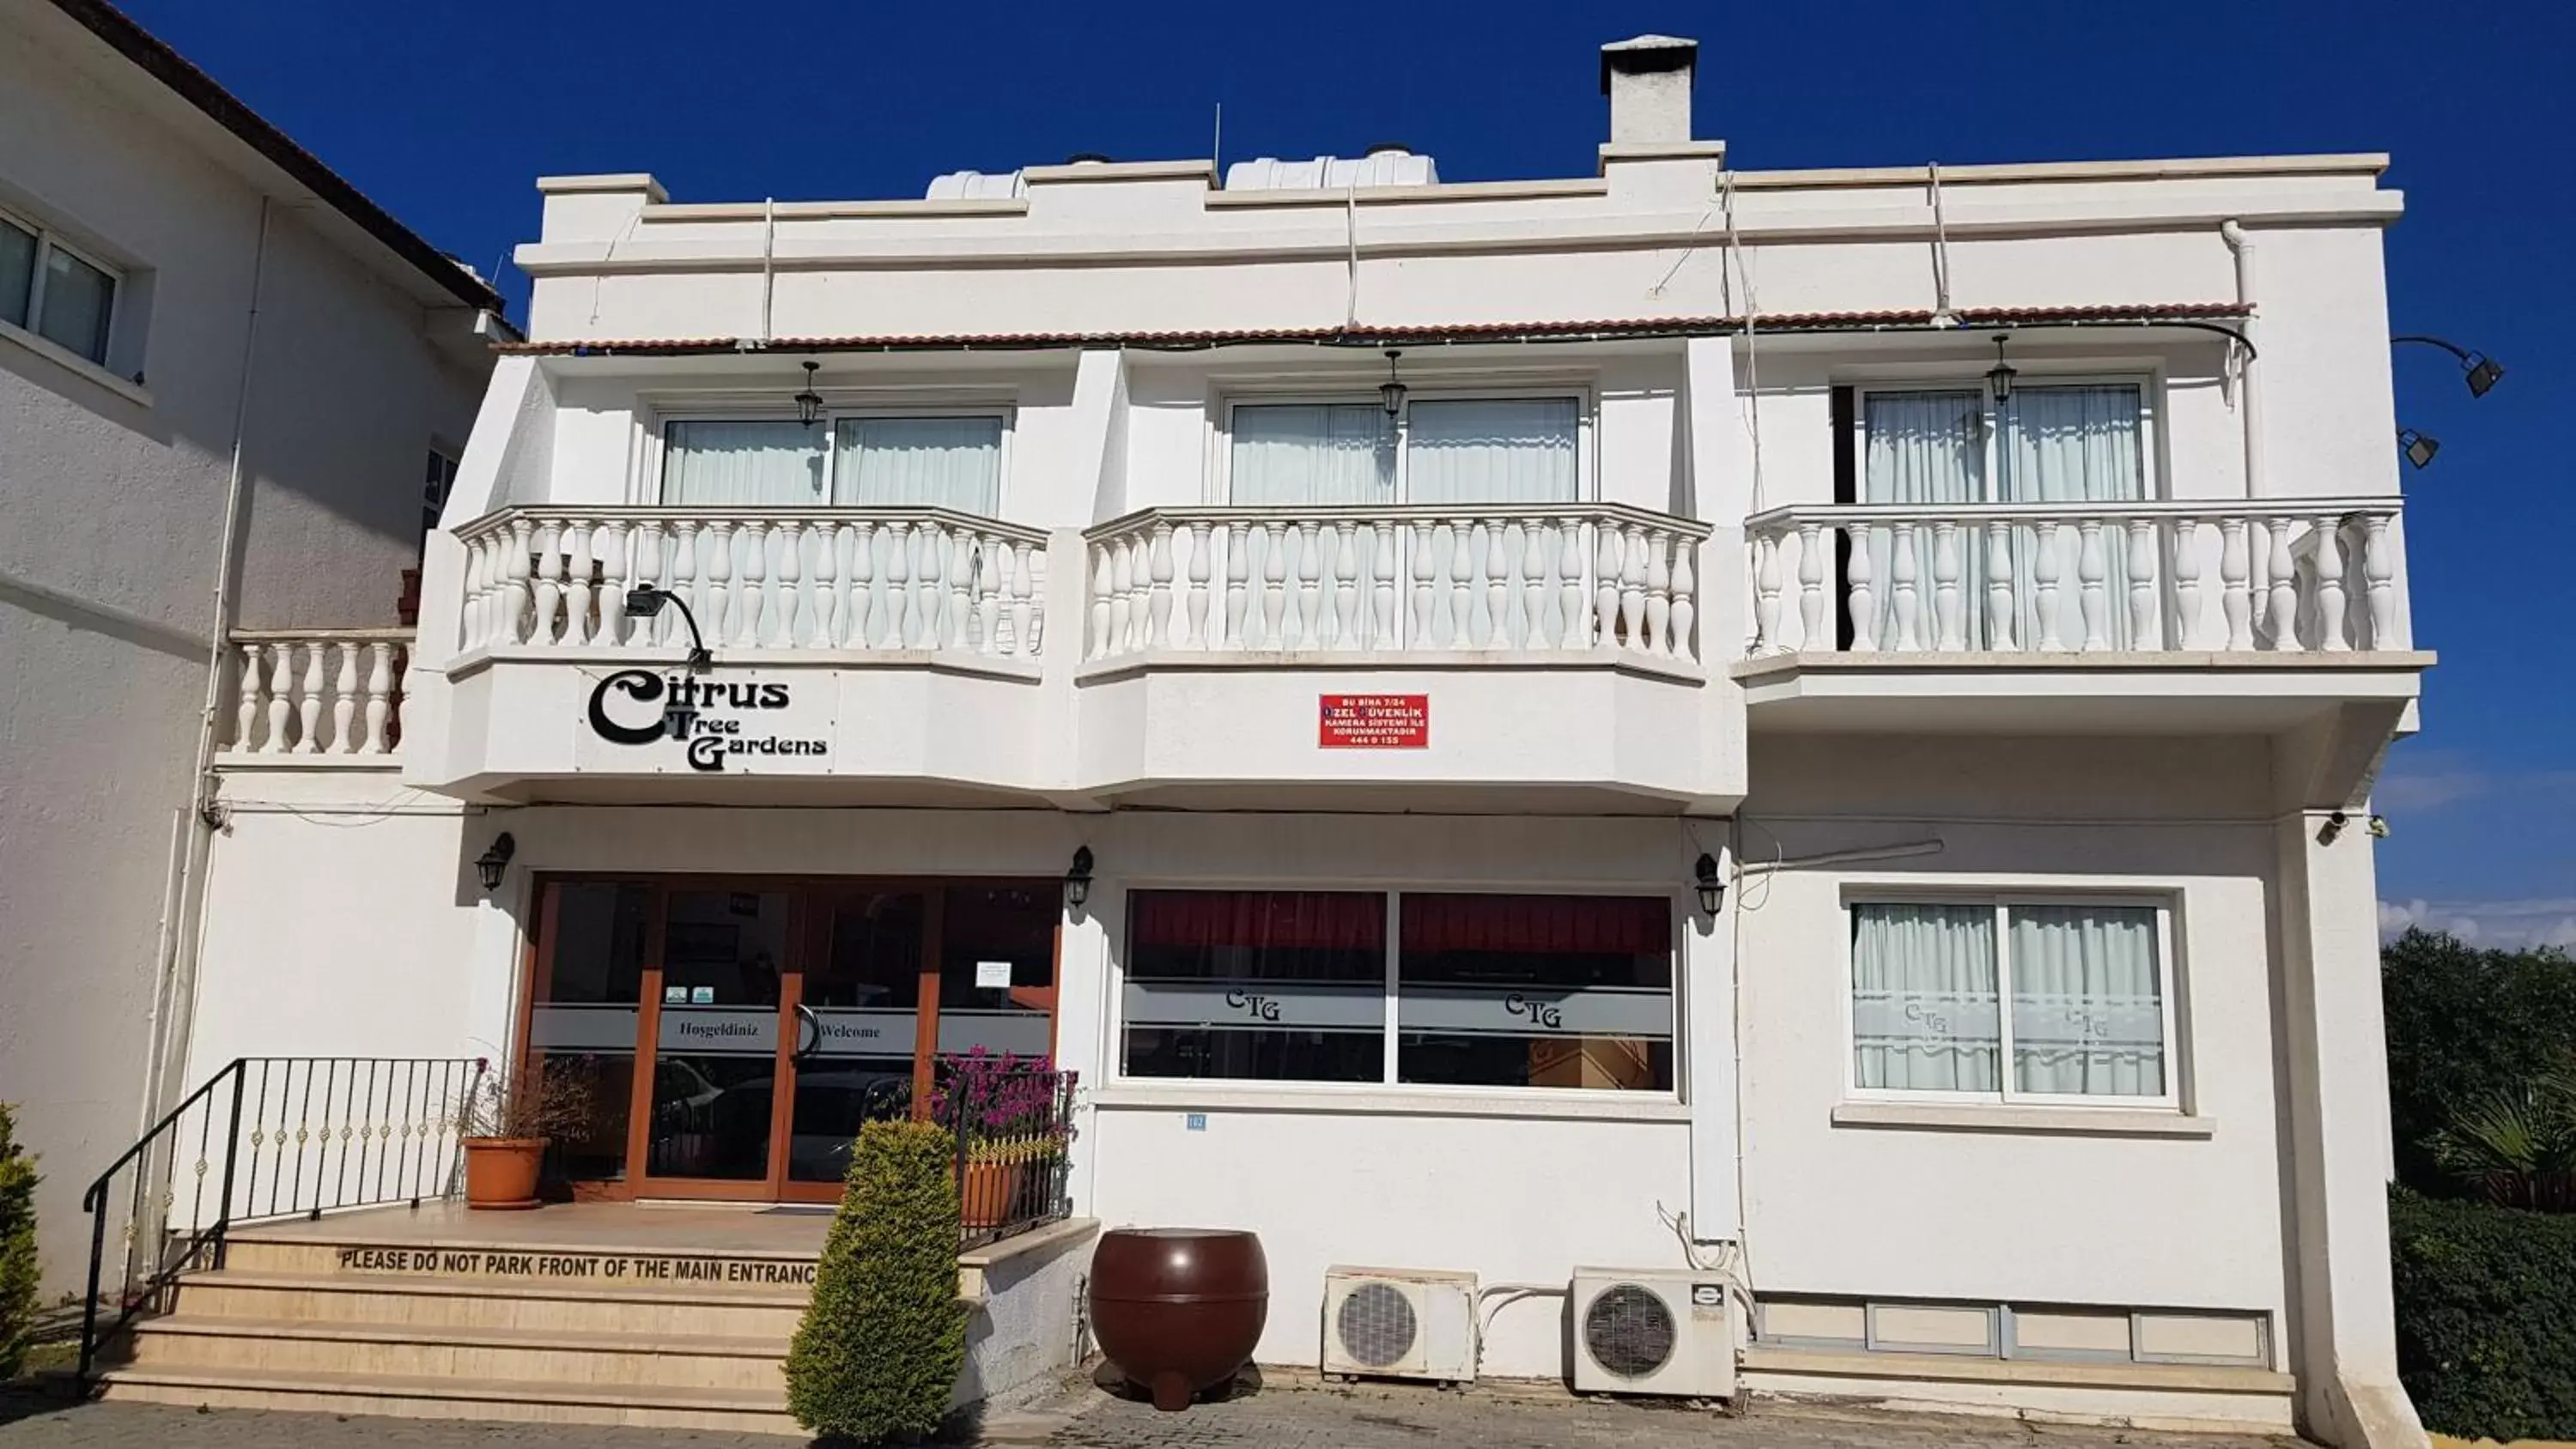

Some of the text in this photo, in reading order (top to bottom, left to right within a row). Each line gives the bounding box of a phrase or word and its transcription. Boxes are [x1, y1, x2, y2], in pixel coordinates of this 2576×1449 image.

[588, 670, 790, 745] Citrus
[1342, 698, 1356, 706] BU
[665, 710, 740, 741] Tree
[688, 736, 827, 771] Gardens
[1226, 988, 1279, 1022] CTG
[1505, 993, 1562, 1028] CTG
[820, 1023, 880, 1038] Welcome
[341, 1249, 816, 1284] PLEASE DO NOT PARK FRONT OF THE MAIN ENTRANC
